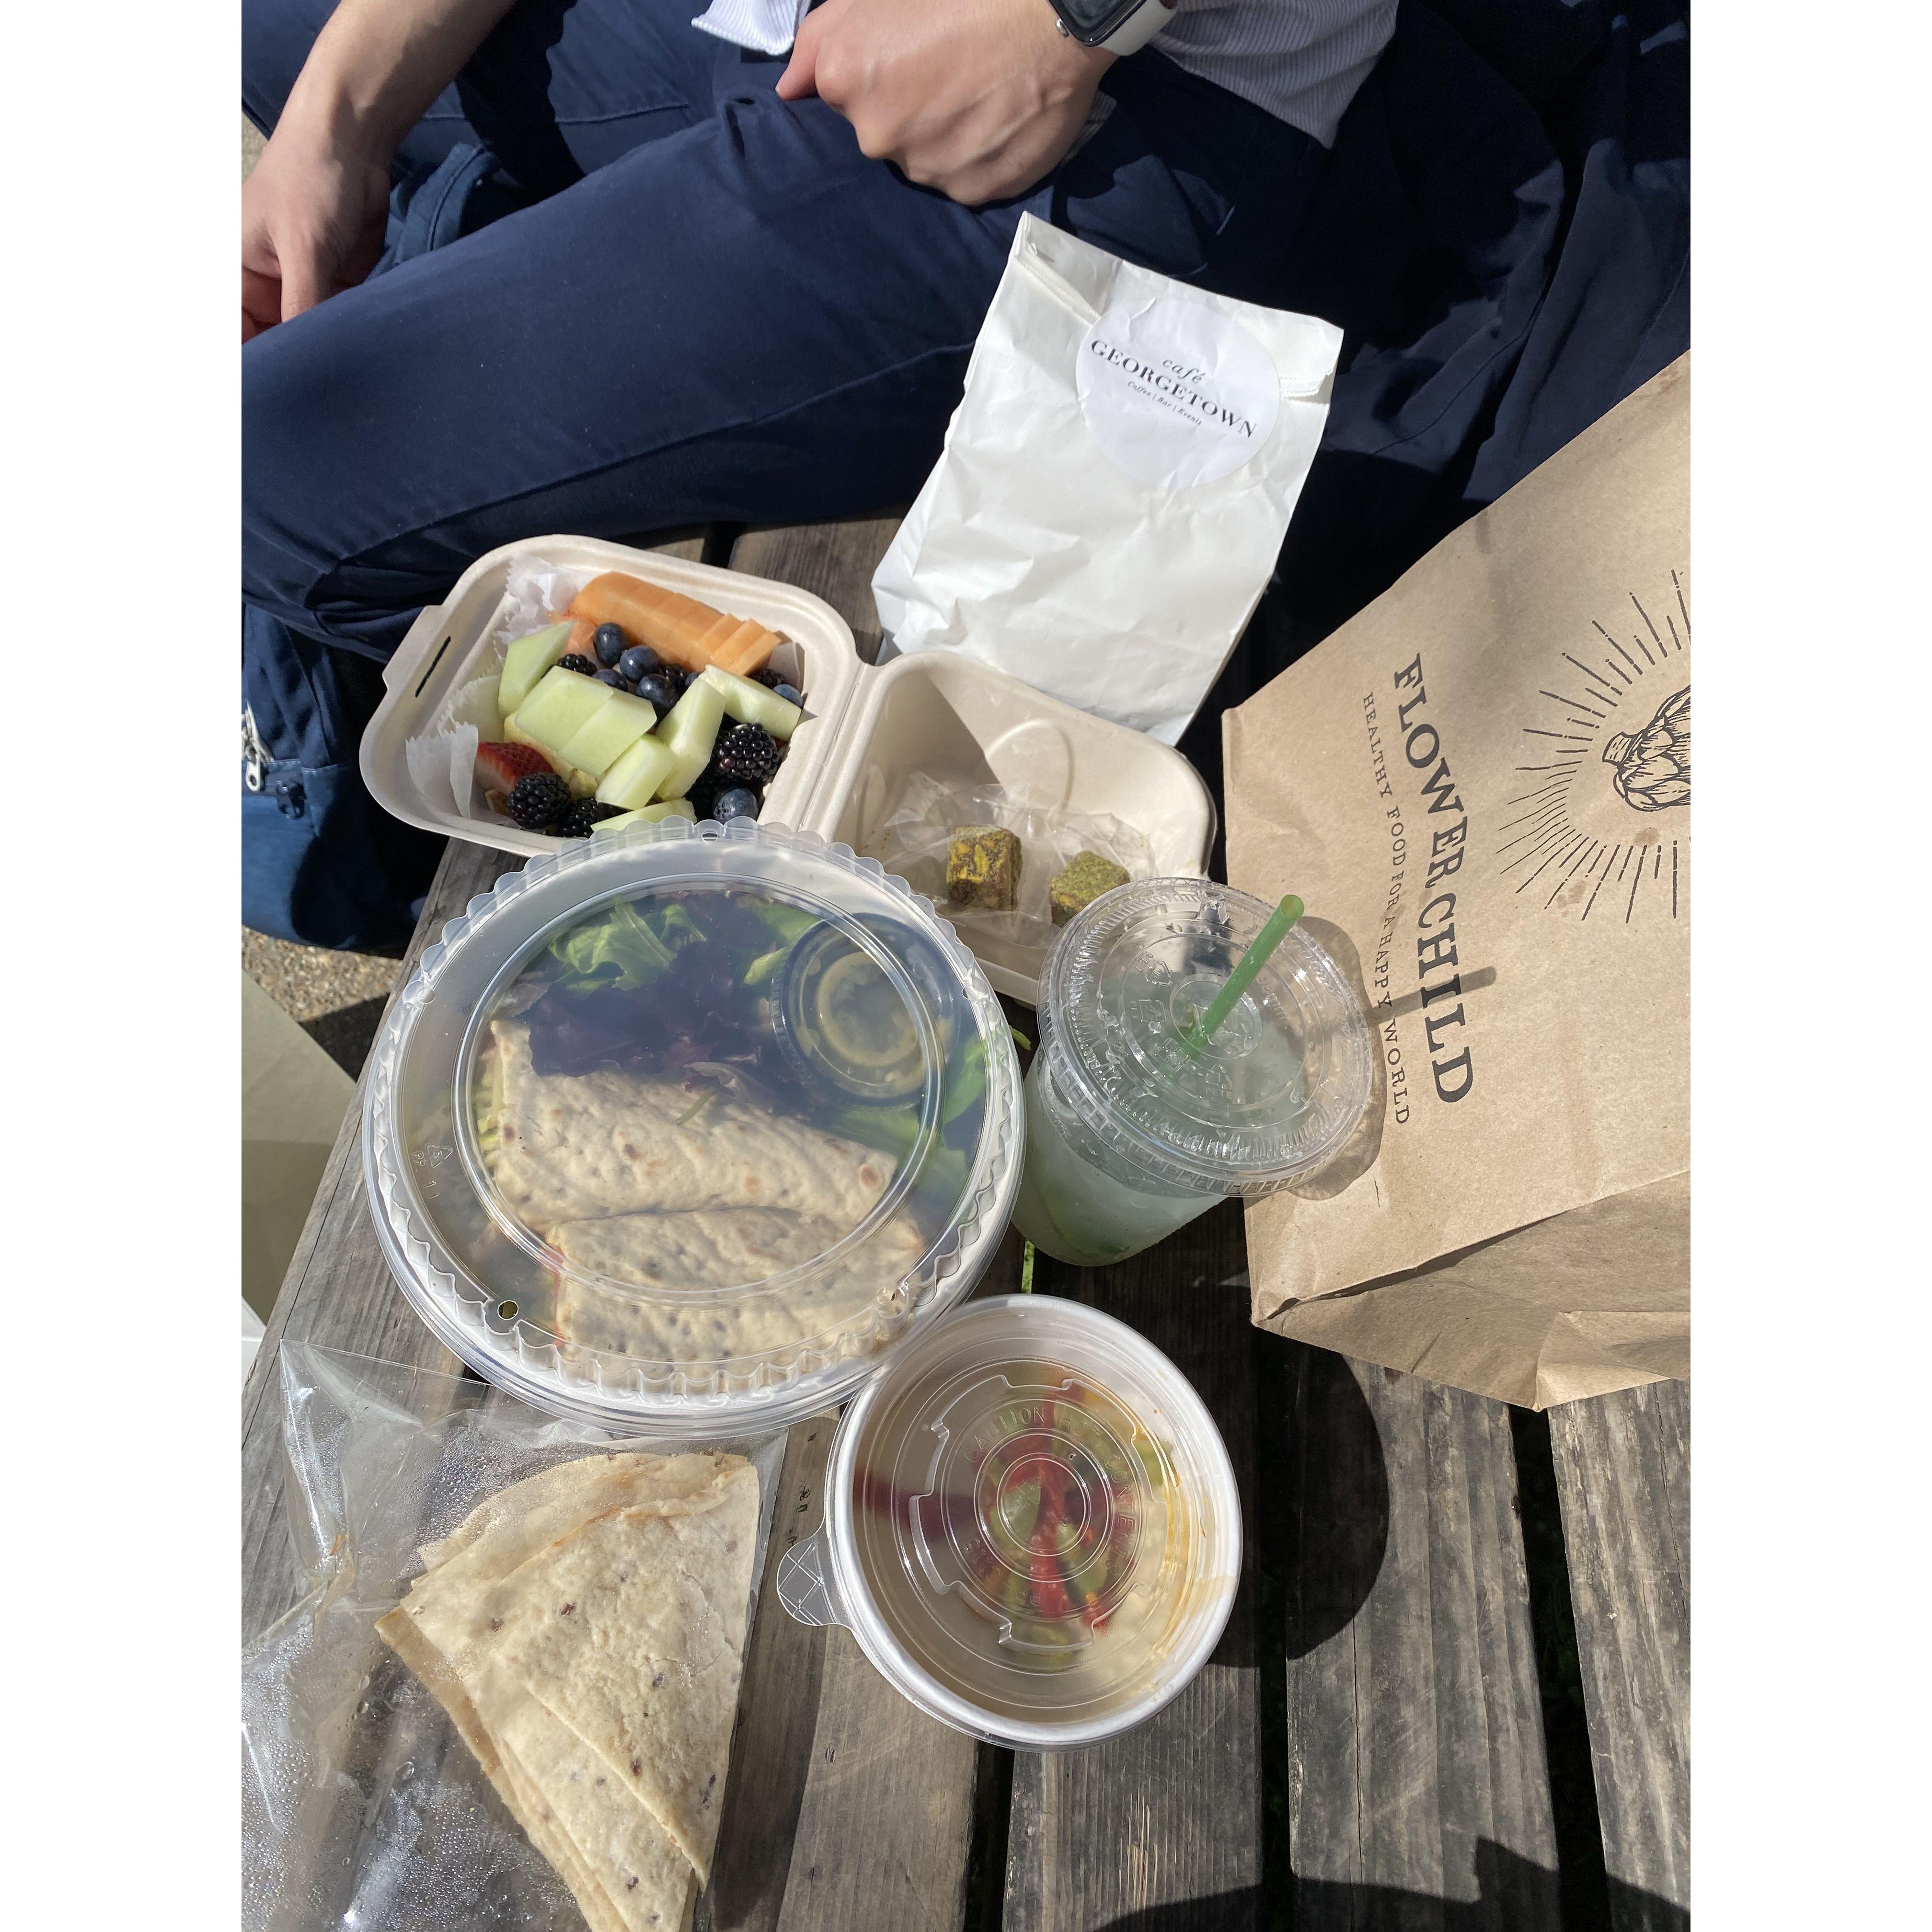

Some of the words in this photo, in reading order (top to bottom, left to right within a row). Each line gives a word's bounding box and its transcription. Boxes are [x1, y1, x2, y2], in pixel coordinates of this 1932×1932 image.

[1091, 340, 1257, 437] GEORGETOWN
[1127, 381, 1151, 396] Coffee
[1157, 396, 1173, 408] Bar
[1178, 408, 1202, 426] Events
[1162, 359, 1206, 383] café
[1363, 691, 1392, 798] HEALTHY
[1394, 652, 1468, 889] FLOWER
[1387, 805, 1406, 866] FOOD
[1384, 916, 1395, 929] A
[1388, 871, 1404, 912] FOR
[1374, 932, 1392, 1008] HAPPY
[1417, 893, 1473, 1103] CHILD
[1384, 1018, 1410, 1124] WORLD
[964, 1406, 1046, 1462] CAUTION
[1059, 1414, 1101, 1436] HOT
[1104, 1455, 1135, 1572] CONTENTS
